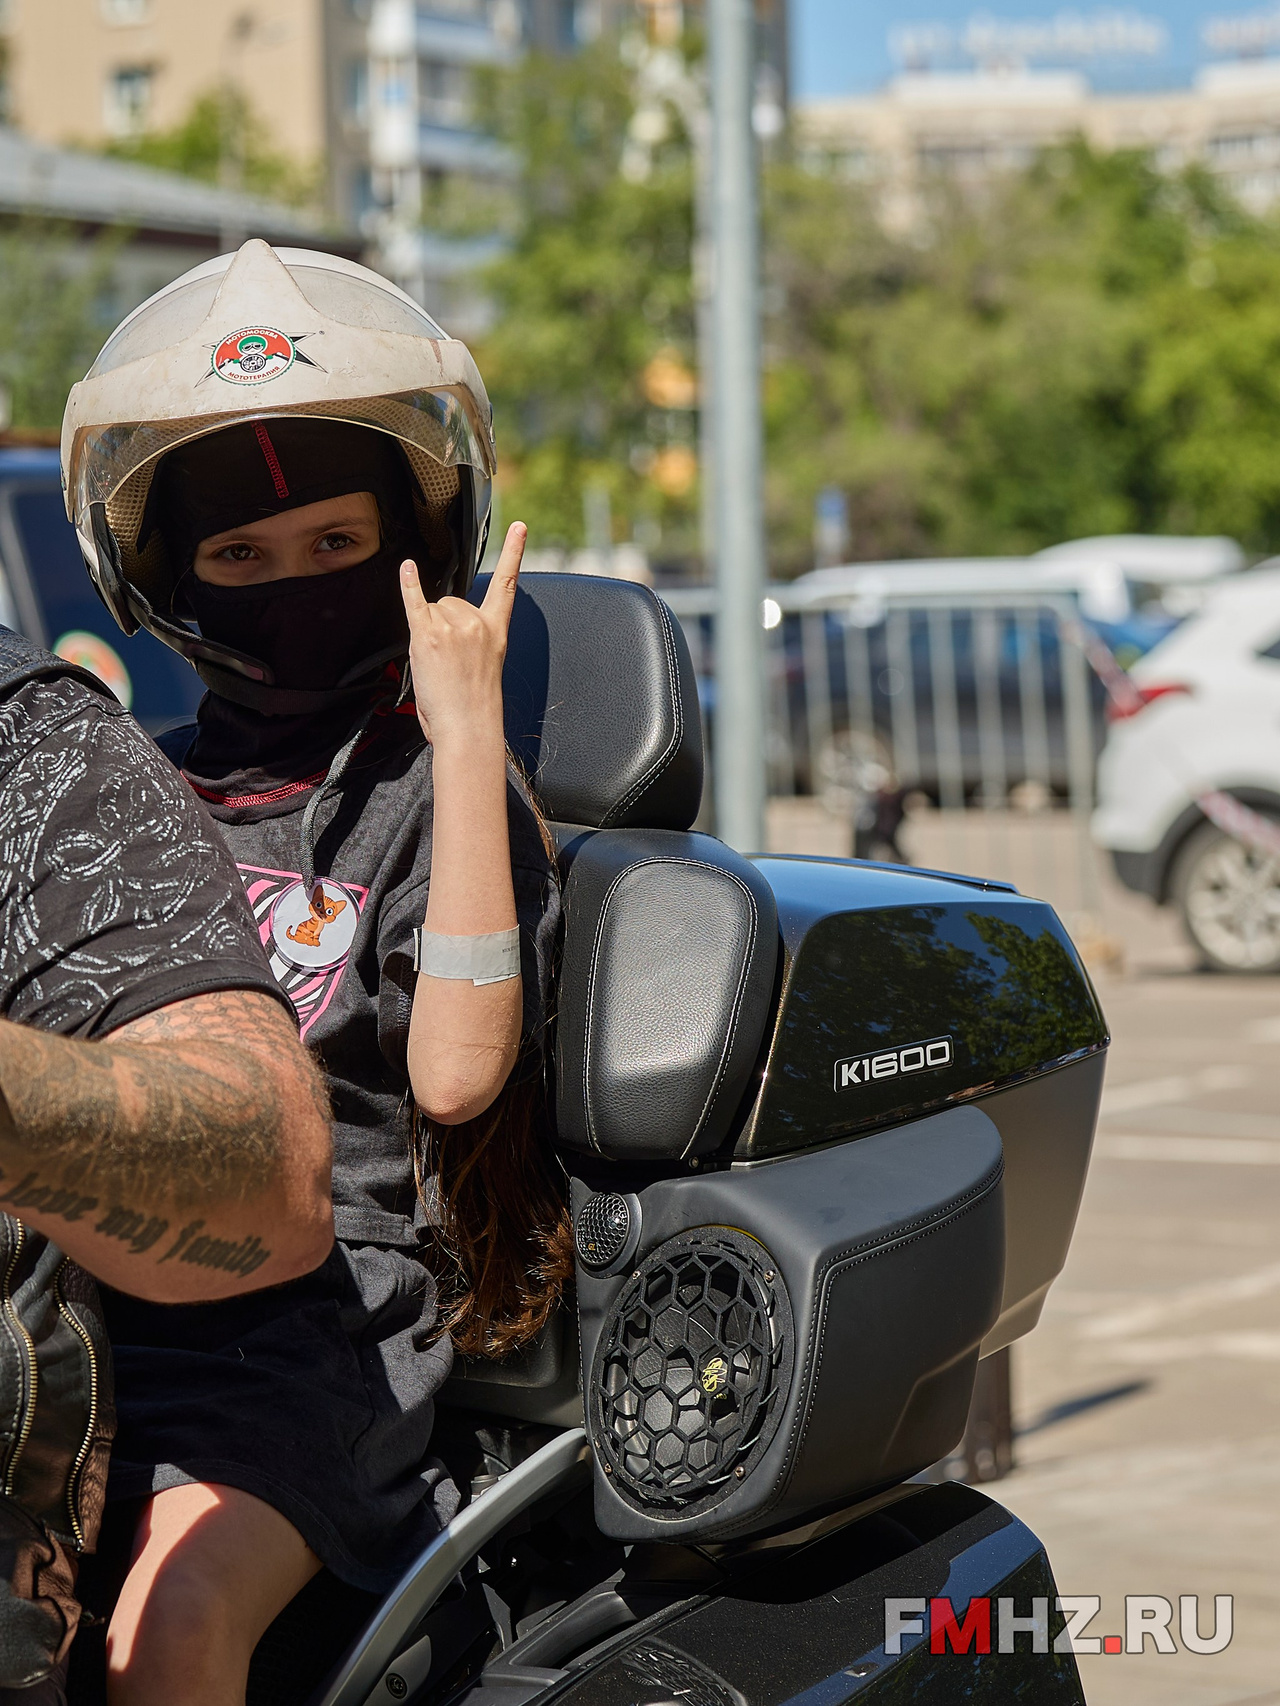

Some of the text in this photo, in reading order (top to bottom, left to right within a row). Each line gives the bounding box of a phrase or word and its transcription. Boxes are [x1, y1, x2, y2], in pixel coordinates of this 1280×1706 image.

[226, 329, 278, 346] МОТОМОСКВА
[227, 366, 280, 381] МОТОТЕРАПИЯ
[841, 1041, 950, 1087] K1600
[95, 1204, 169, 1254] my
[156, 1219, 271, 1278] family
